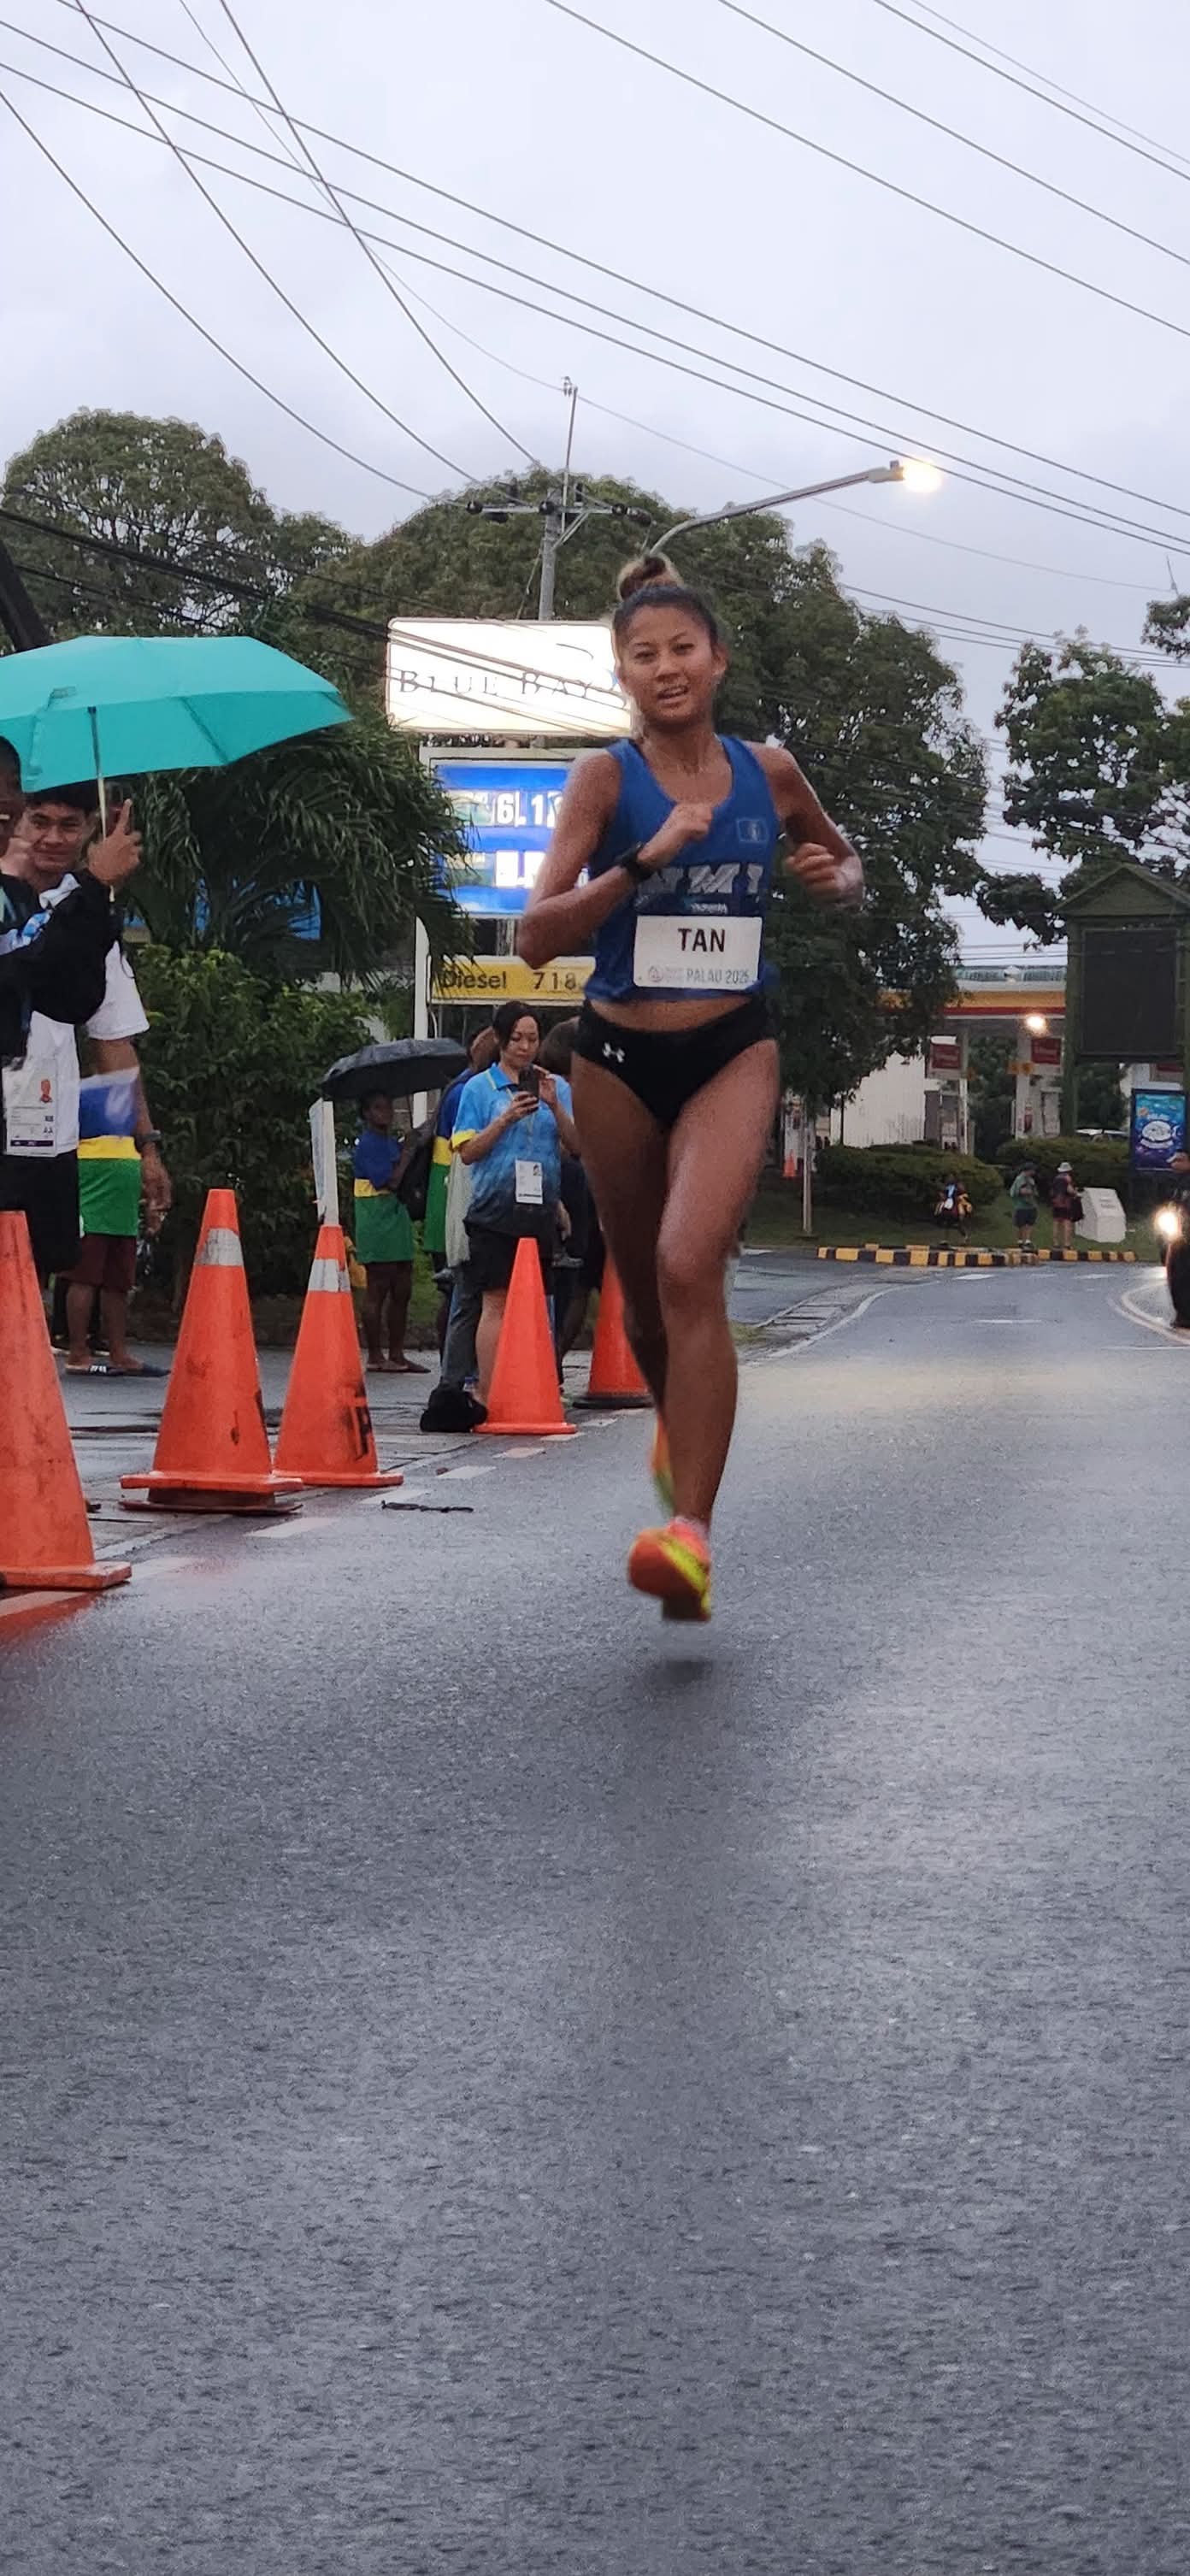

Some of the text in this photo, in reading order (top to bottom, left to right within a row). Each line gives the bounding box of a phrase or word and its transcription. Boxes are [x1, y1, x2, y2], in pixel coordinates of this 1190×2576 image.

[399, 669, 593, 700] BLUE BAY
[677, 928, 726, 952] TAN
[439, 970, 507, 989] Diesel
[686, 968, 722, 984] PALAU
[724, 968, 751, 985] 2025
